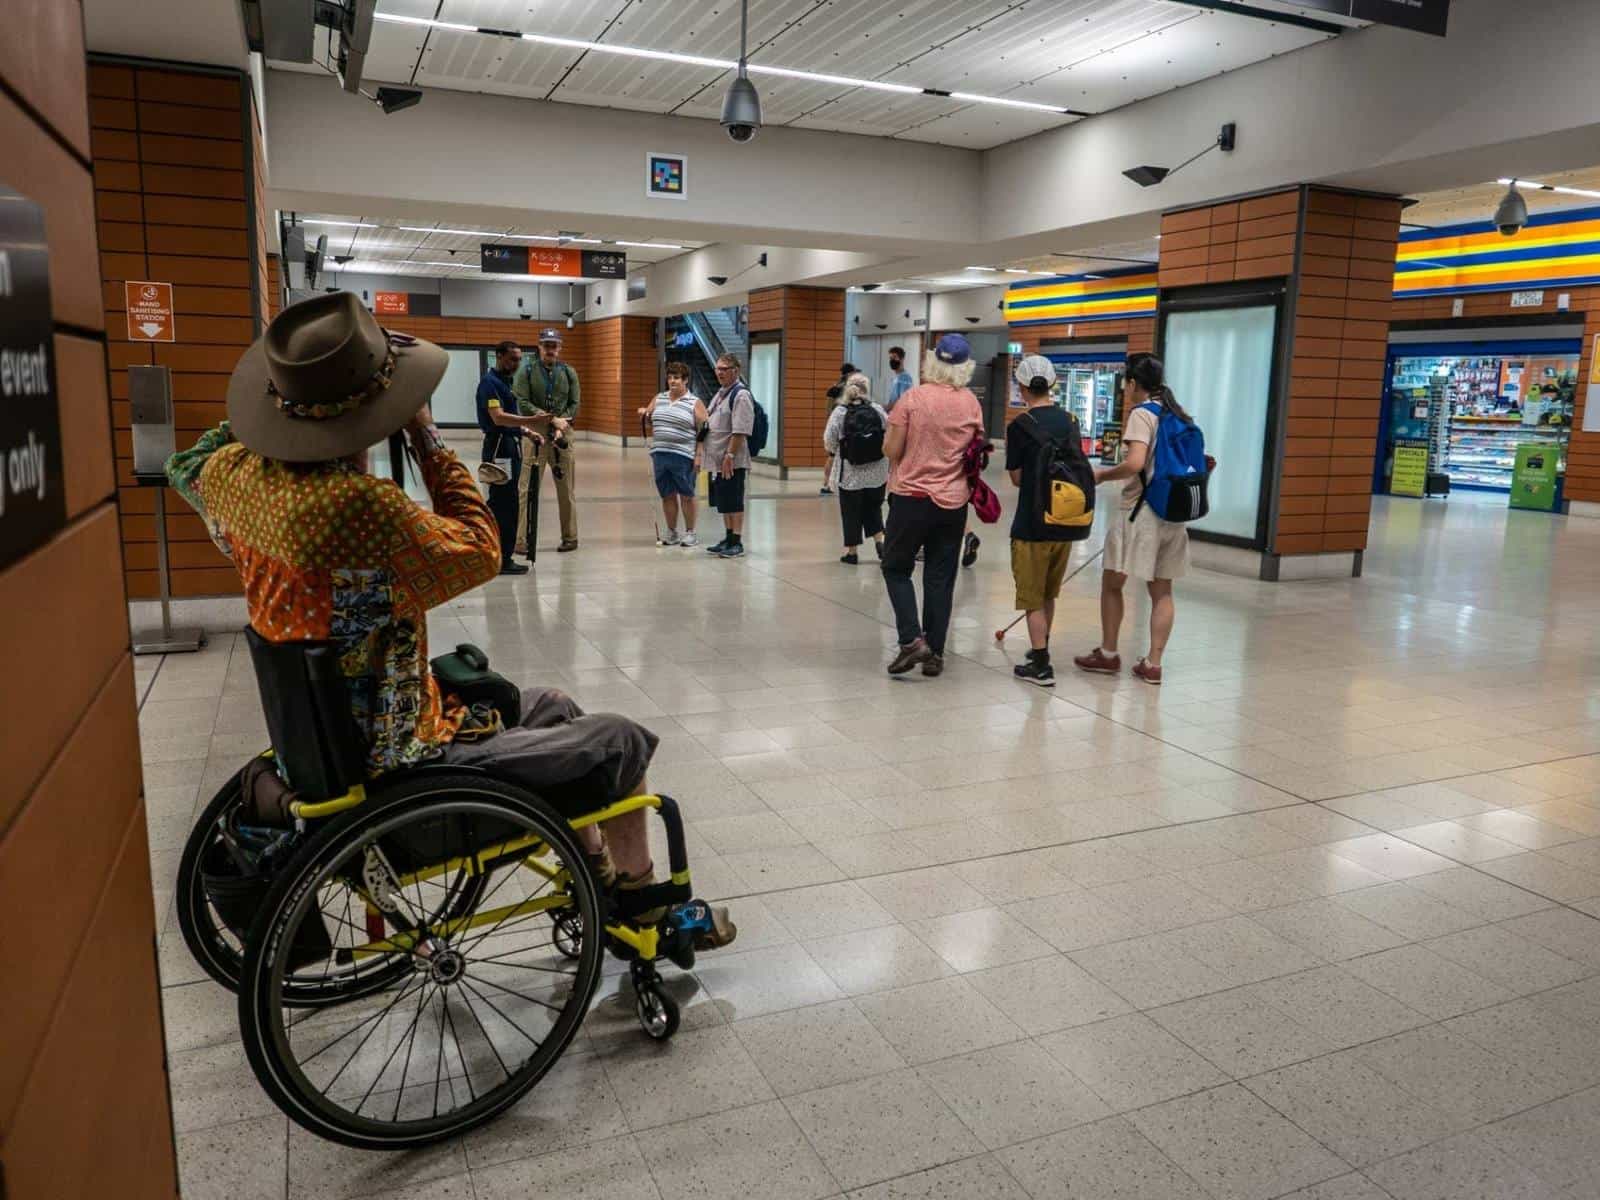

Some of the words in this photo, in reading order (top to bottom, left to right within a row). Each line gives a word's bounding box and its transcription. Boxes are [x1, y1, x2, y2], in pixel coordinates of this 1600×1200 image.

[552, 263, 560, 272] 2
[399, 302, 405, 311] 2
[1, 344, 48, 396] event
[9, 431, 44, 500] only
